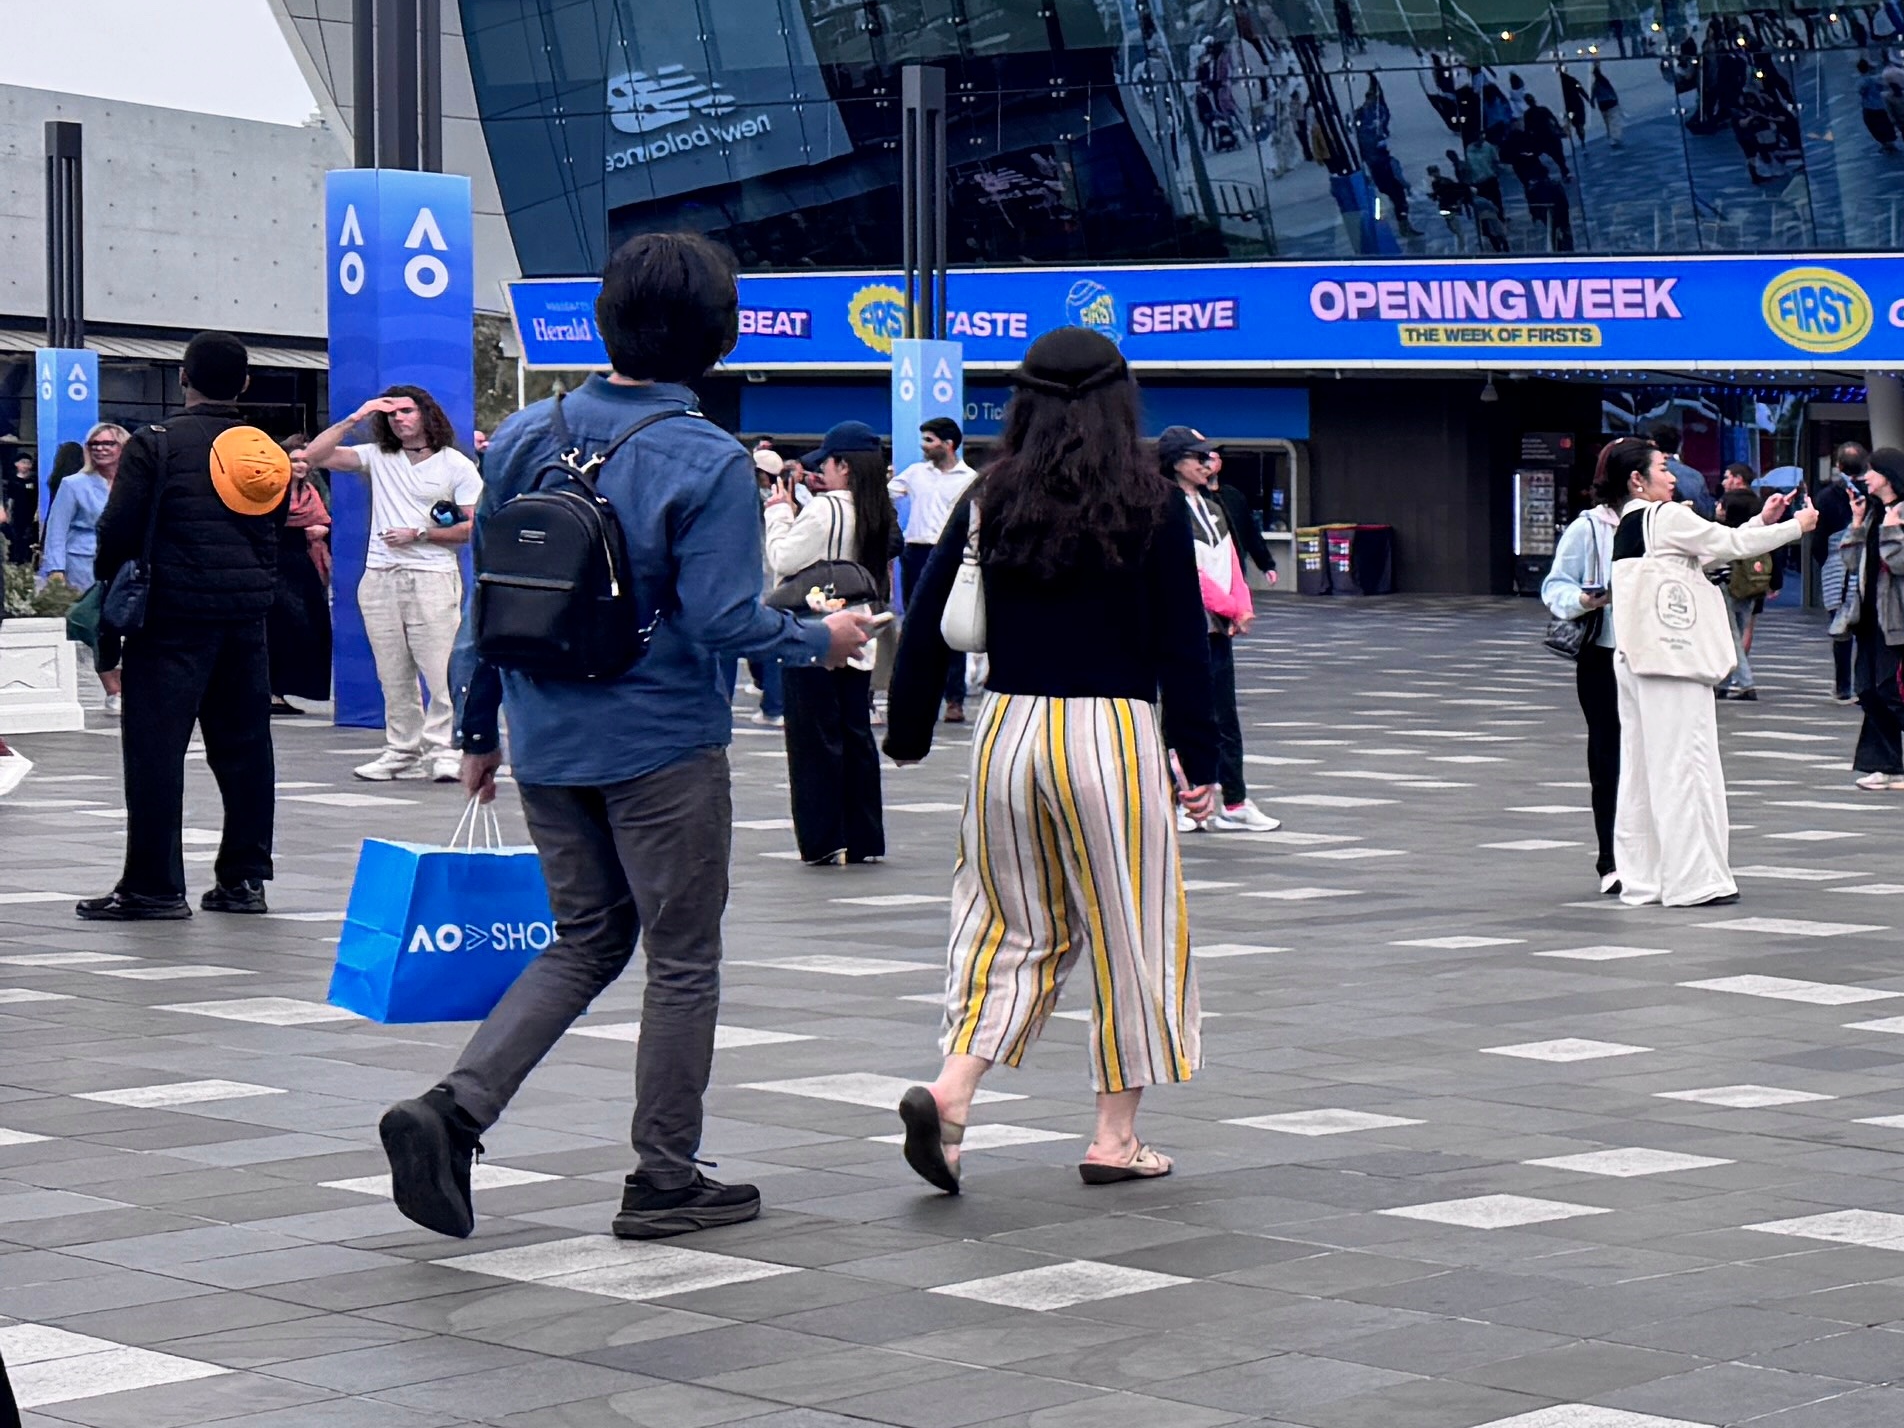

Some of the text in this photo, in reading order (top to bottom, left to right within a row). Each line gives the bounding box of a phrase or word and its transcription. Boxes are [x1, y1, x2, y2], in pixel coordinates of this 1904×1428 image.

[1310, 278, 1682, 321] OPENING WEEK
[1778, 286, 1853, 335] FIRST
[532, 317, 593, 341] Herald
[738, 311, 807, 336] BEAT
[1133, 301, 1234, 333] SERVE
[1405, 328, 1593, 343] THE WEEK OF FIRSTS
